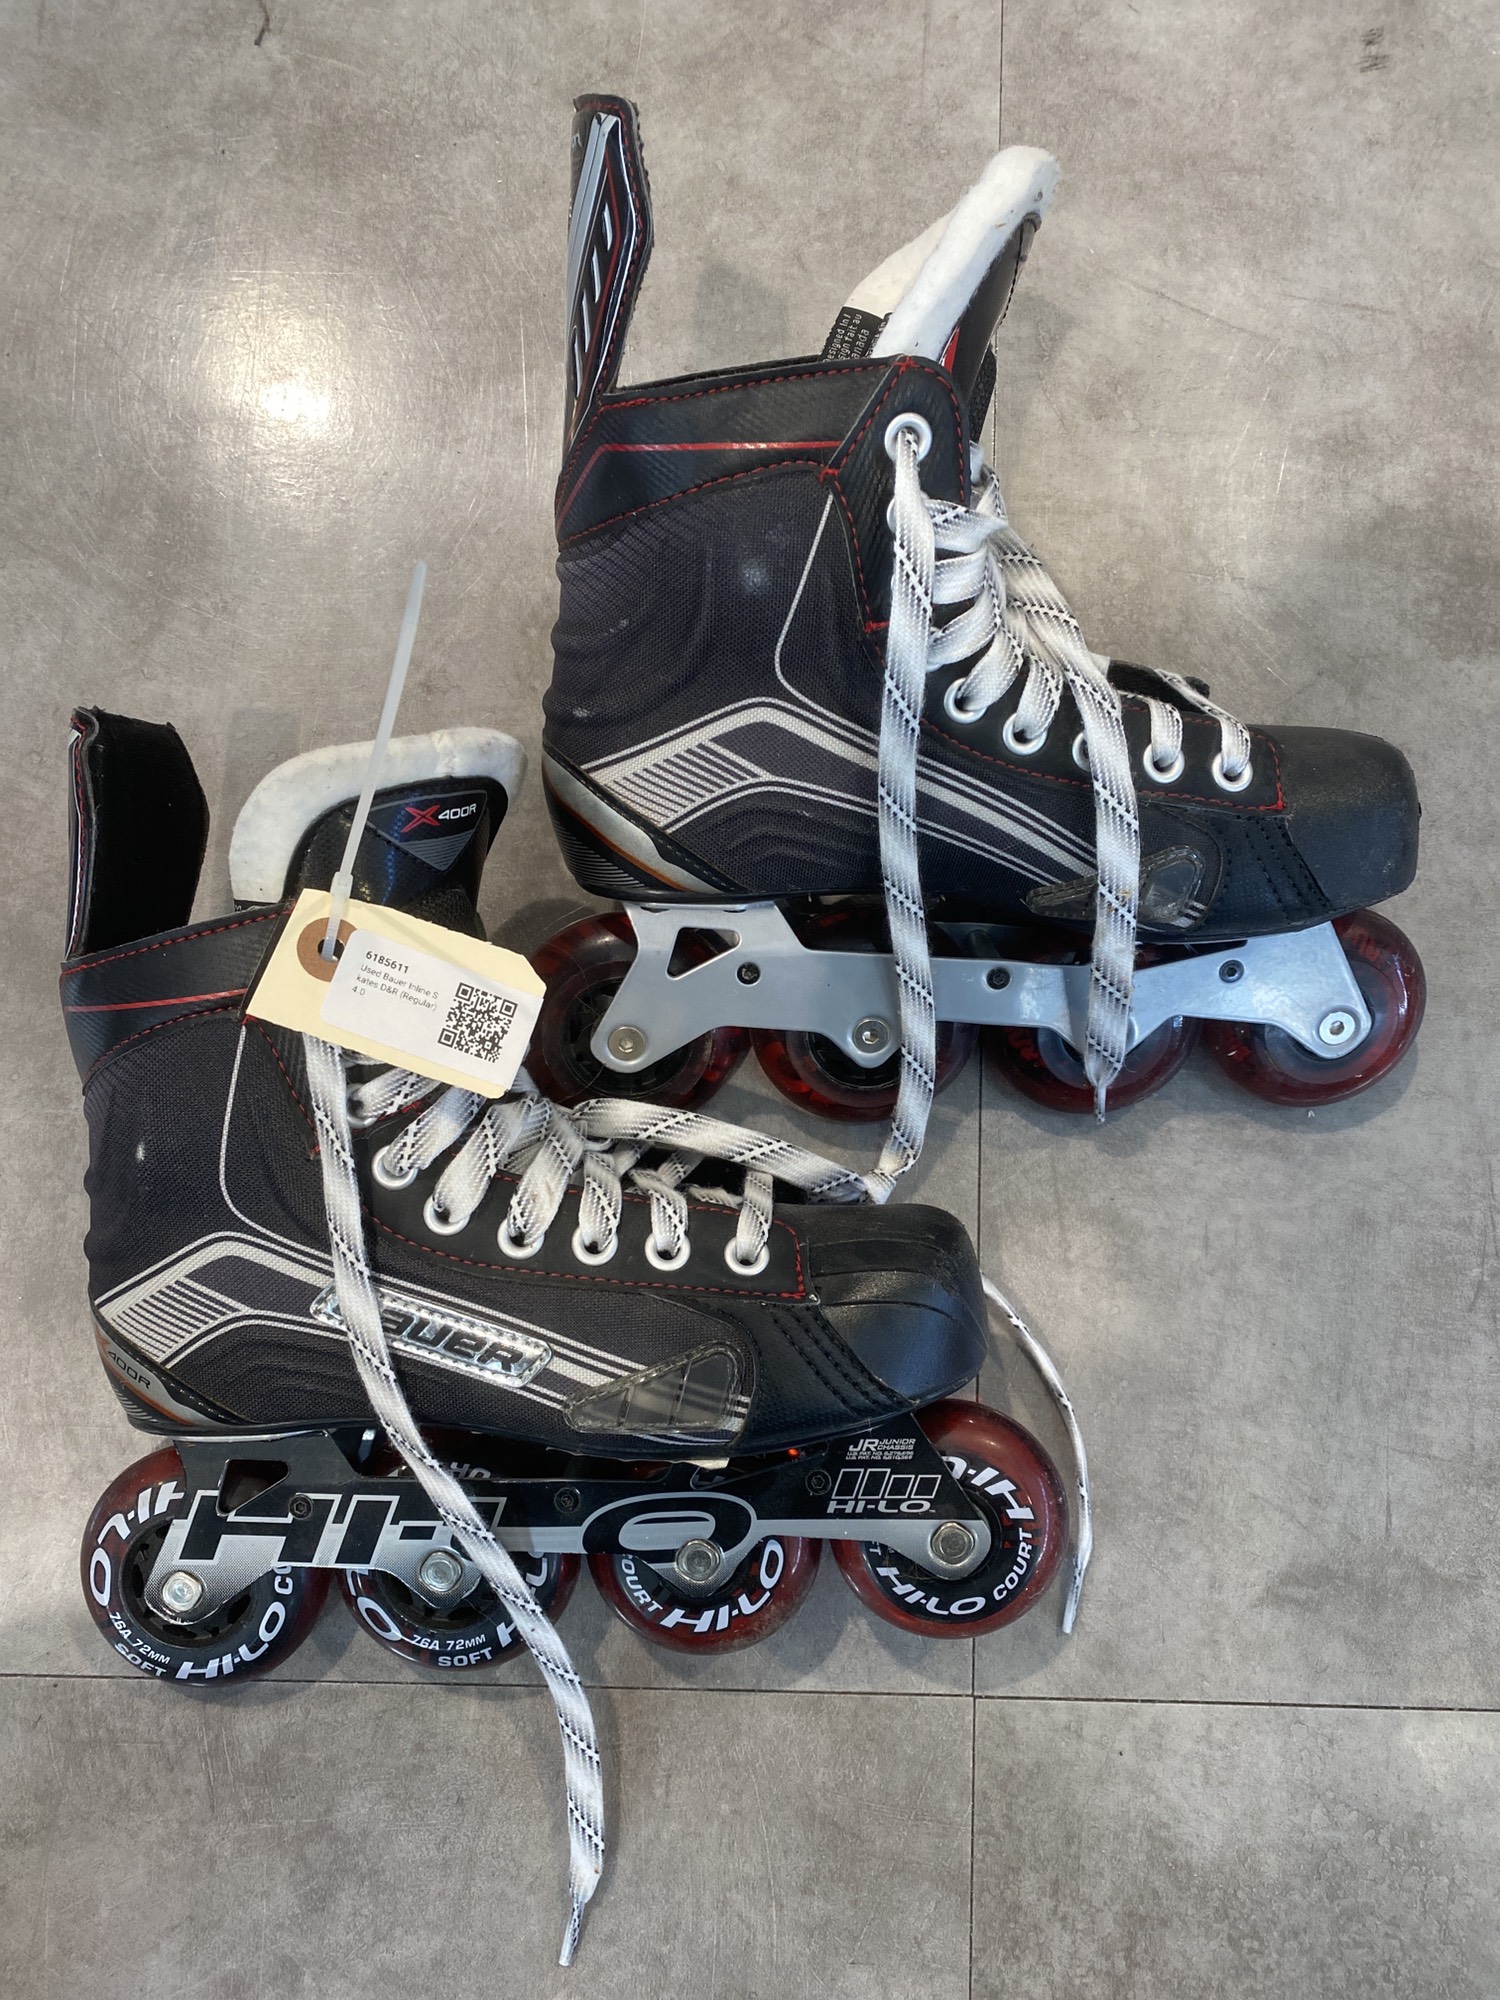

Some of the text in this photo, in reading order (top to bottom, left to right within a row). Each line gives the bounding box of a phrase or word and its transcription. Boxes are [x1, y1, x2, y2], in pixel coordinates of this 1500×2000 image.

[844, 325, 858, 342] fait
[852, 313, 862, 325] au
[850, 329, 870, 359] anada
[365, 950, 409, 974] 6185611
[356, 974, 438, 1012] kates D&R (Regular)
[360, 964, 439, 999] Used Bauer Inline S
[380, 1308, 524, 1373] AUER
[108, 1351, 151, 1389] 400R
[848, 1438, 879, 1451] JR
[826, 1500, 931, 1513] HI-LO
[942, 1455, 1035, 1520] HI-L
[993, 1527, 1033, 1601] COURT
[620, 1555, 663, 1613] OURT
[660, 1539, 784, 1633] HI-LO
[876, 1566, 986, 1616] HI-LO
[109, 1611, 171, 1664] 76A 72MM
[175, 1601, 286, 1680] HI-LO
[412, 1633, 486, 1650] 76A 72MM
[114, 1642, 167, 1678] SOFT
[437, 1647, 493, 1667] SOFT
